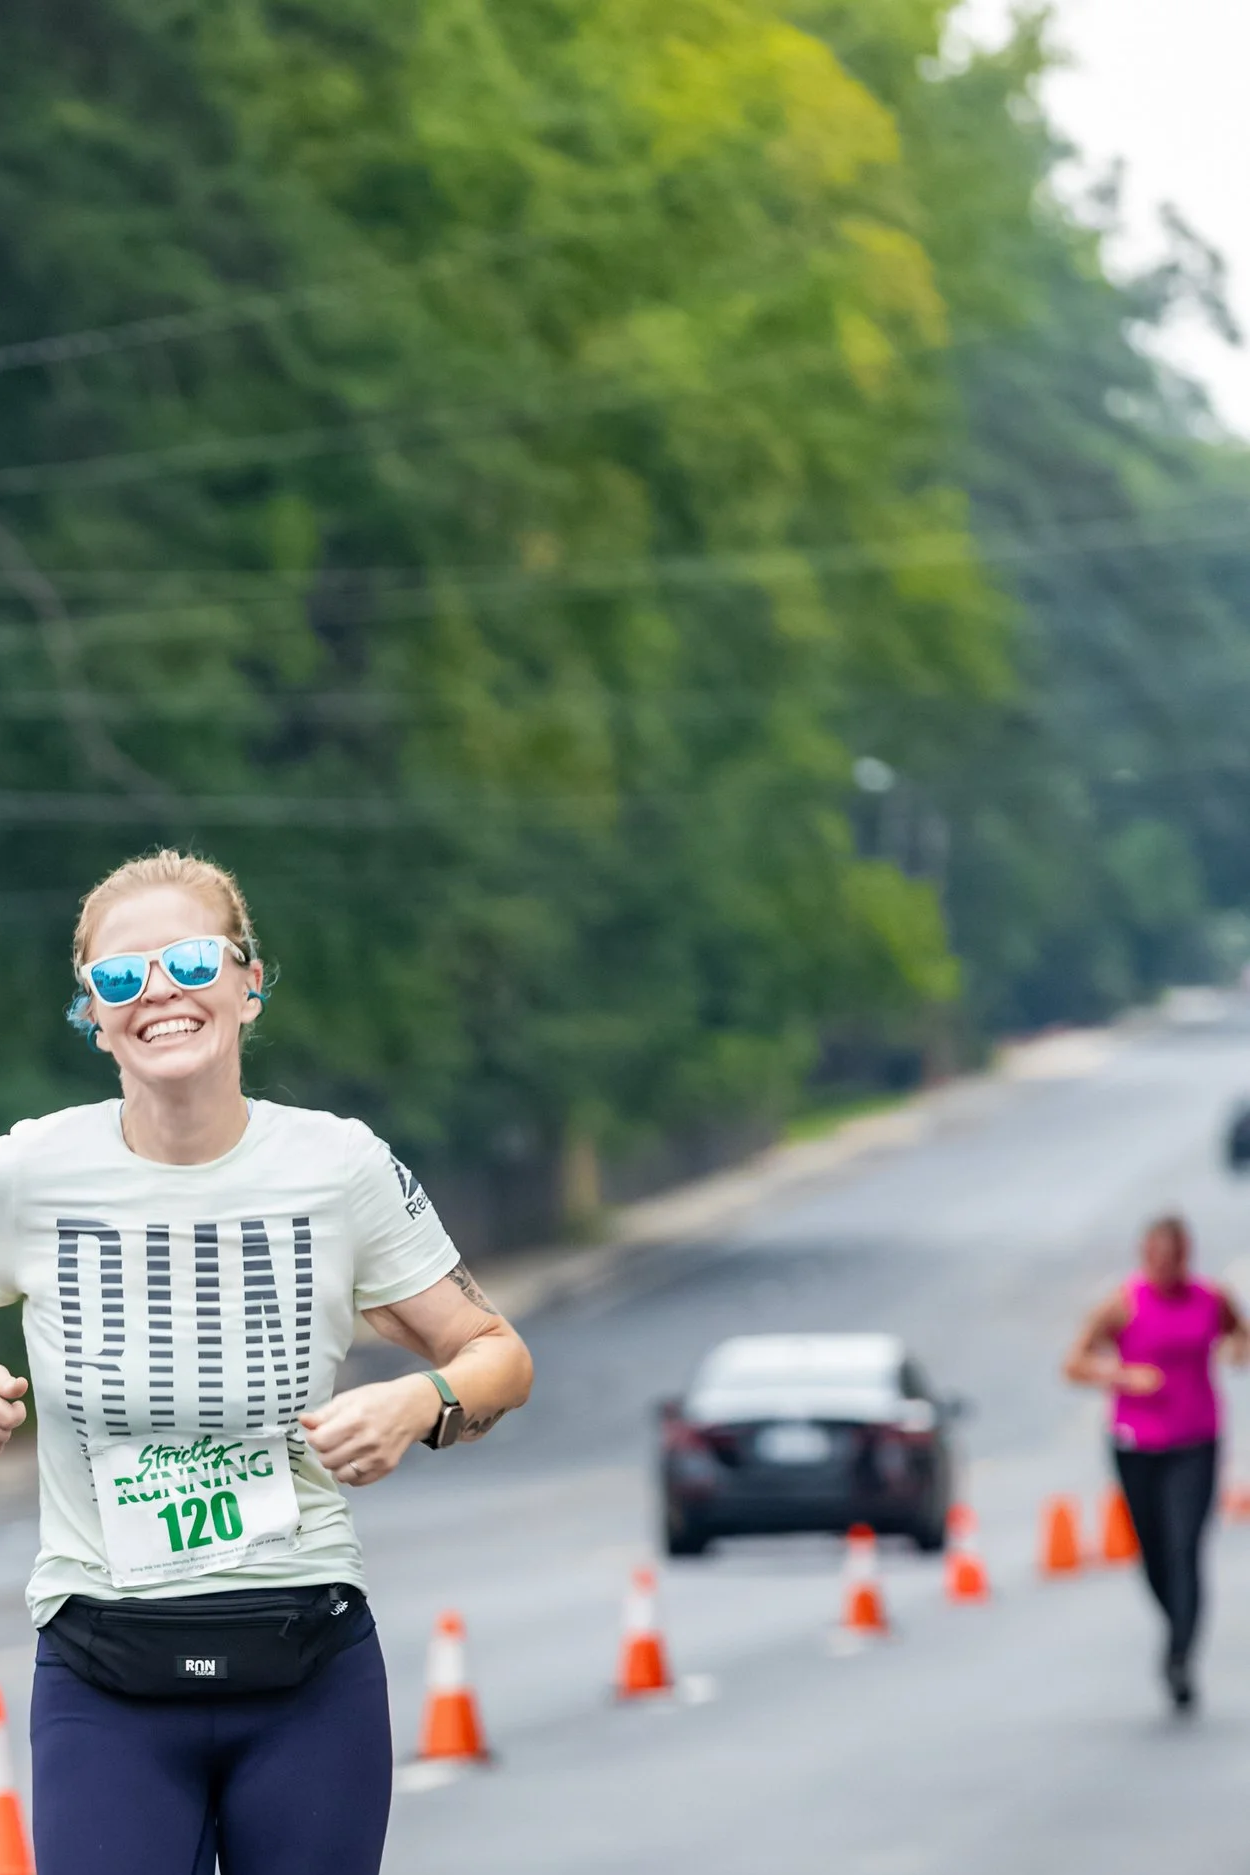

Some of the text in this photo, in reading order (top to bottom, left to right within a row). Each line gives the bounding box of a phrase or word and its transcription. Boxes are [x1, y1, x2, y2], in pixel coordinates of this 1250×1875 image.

[113, 1450, 273, 1506] RUNNING
[138, 1435, 243, 1478] Strictly
[157, 1491, 243, 1552] 120
